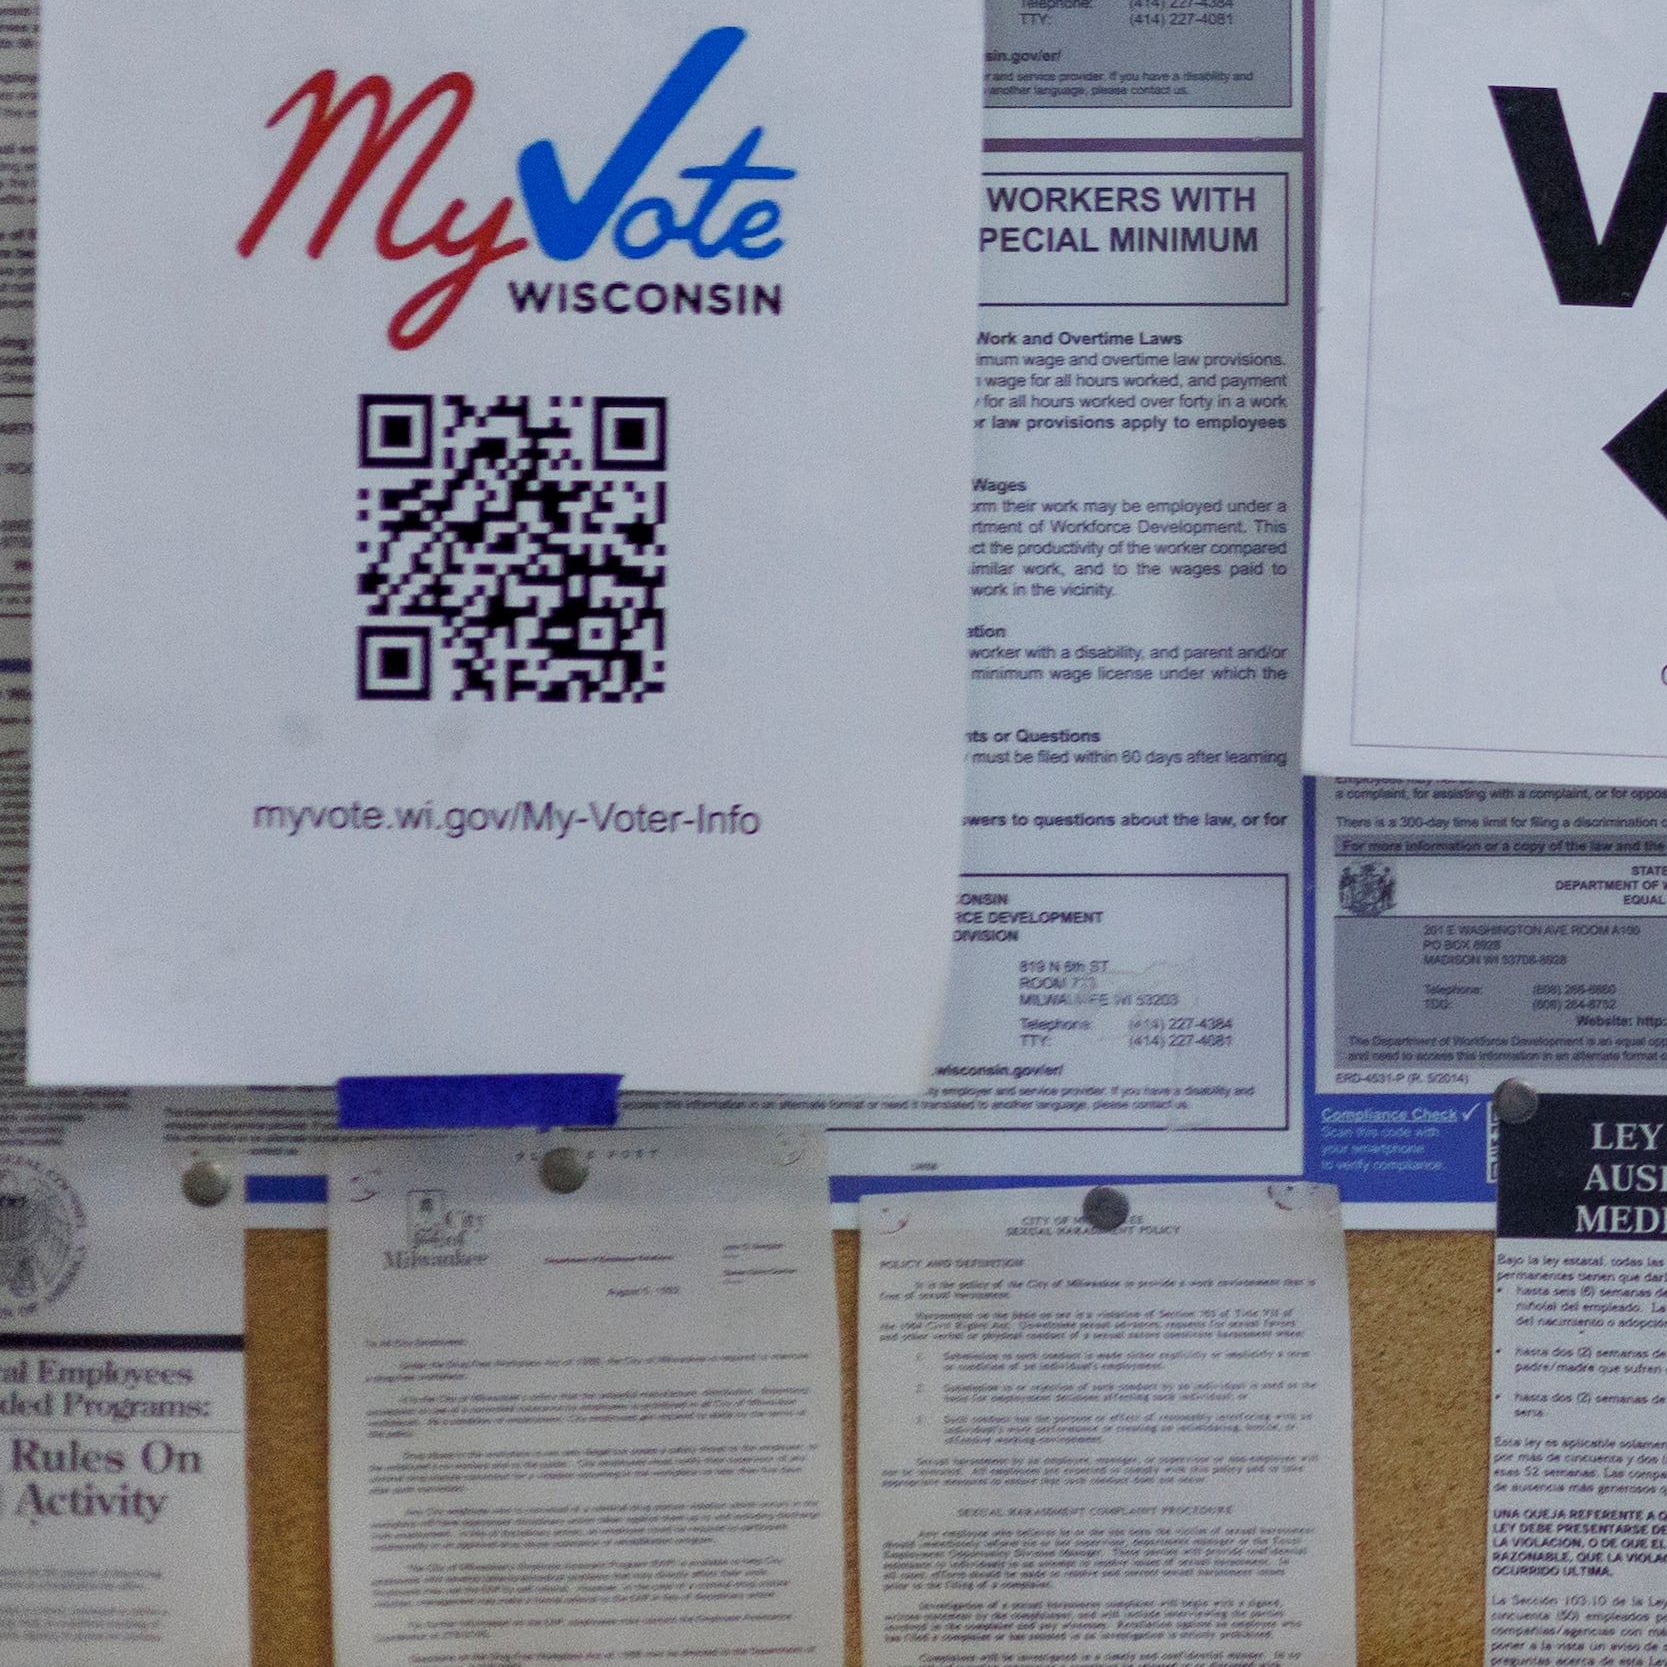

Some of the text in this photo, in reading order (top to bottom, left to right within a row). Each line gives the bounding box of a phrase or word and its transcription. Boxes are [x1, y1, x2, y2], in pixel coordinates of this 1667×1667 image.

[986, 186, 1255, 213] WORKERS WITH
[978, 226, 1258, 253] PECIAL MINIMUM
[508, 281, 782, 316] WISCONSIN
[253, 800, 761, 840] myvote.wi.gov/My-Voter-Info
[1591, 1122, 1664, 1151] LEY
[12, 1438, 202, 1474] Rules On
[17, 1482, 166, 1525] Activity
